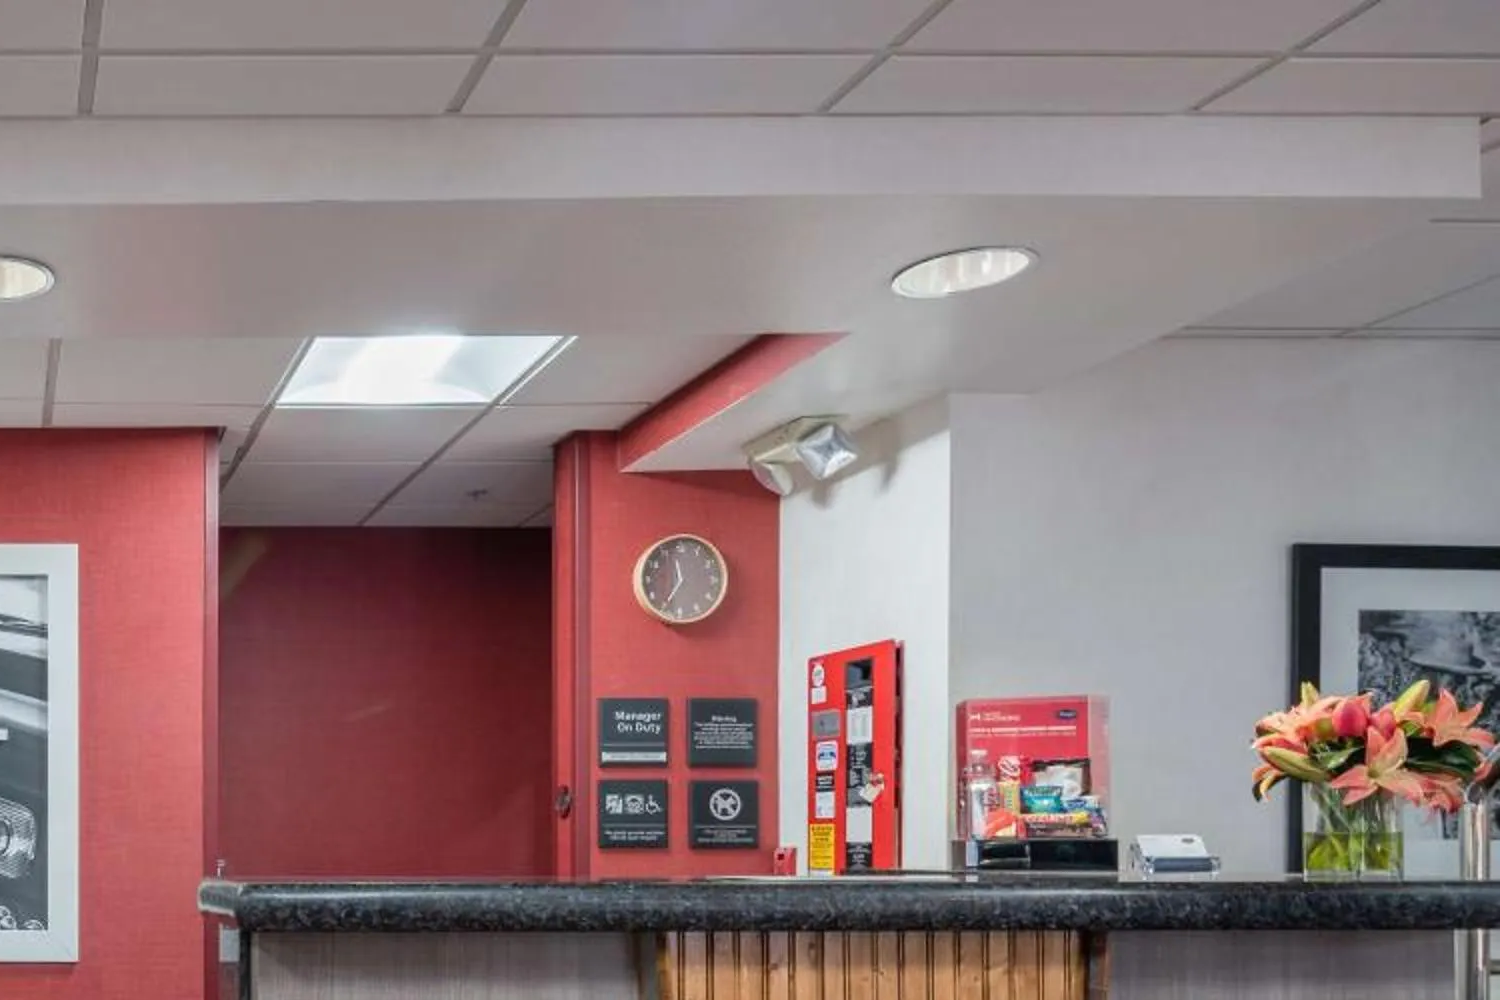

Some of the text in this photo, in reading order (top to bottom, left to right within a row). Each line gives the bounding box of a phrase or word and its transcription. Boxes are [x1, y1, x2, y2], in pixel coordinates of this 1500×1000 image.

[615, 711, 661, 723] Manager
[617, 722, 661, 735] On Duty
